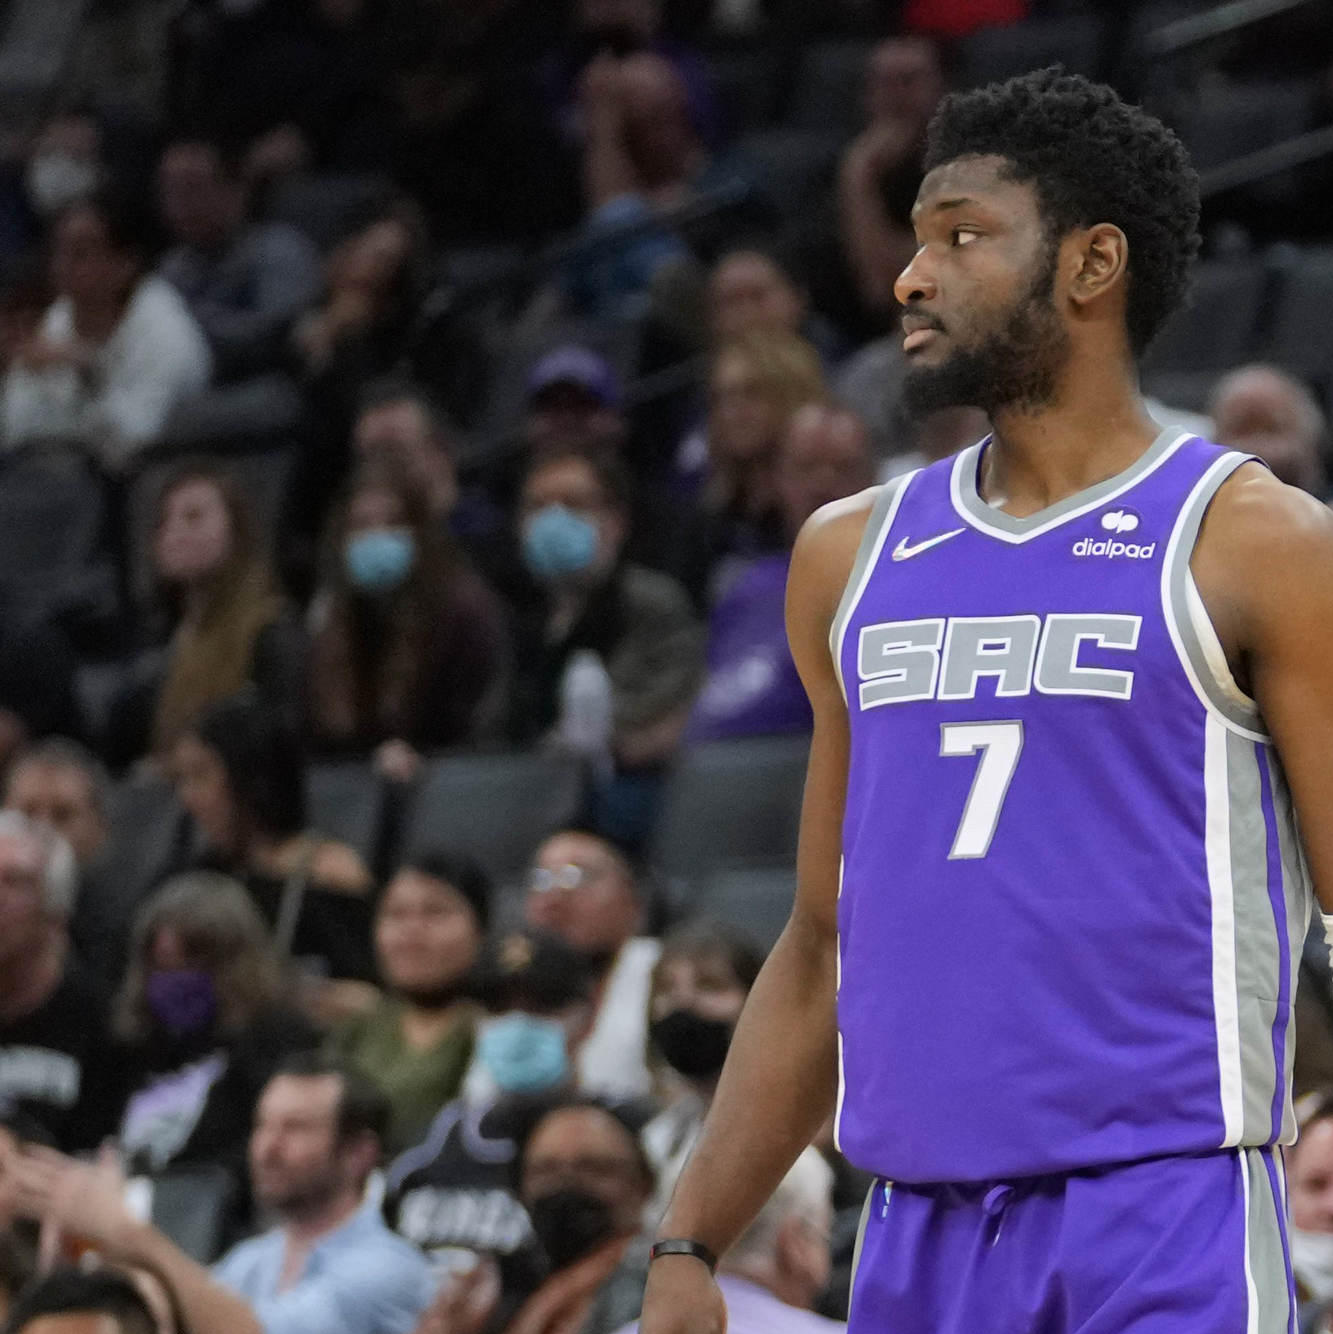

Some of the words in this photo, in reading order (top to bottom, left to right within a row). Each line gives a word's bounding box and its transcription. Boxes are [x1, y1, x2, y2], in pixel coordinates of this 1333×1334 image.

[1072, 536, 1156, 560] dialpad
[857, 613, 1143, 711] SAC
[938, 720, 1024, 861] 7
